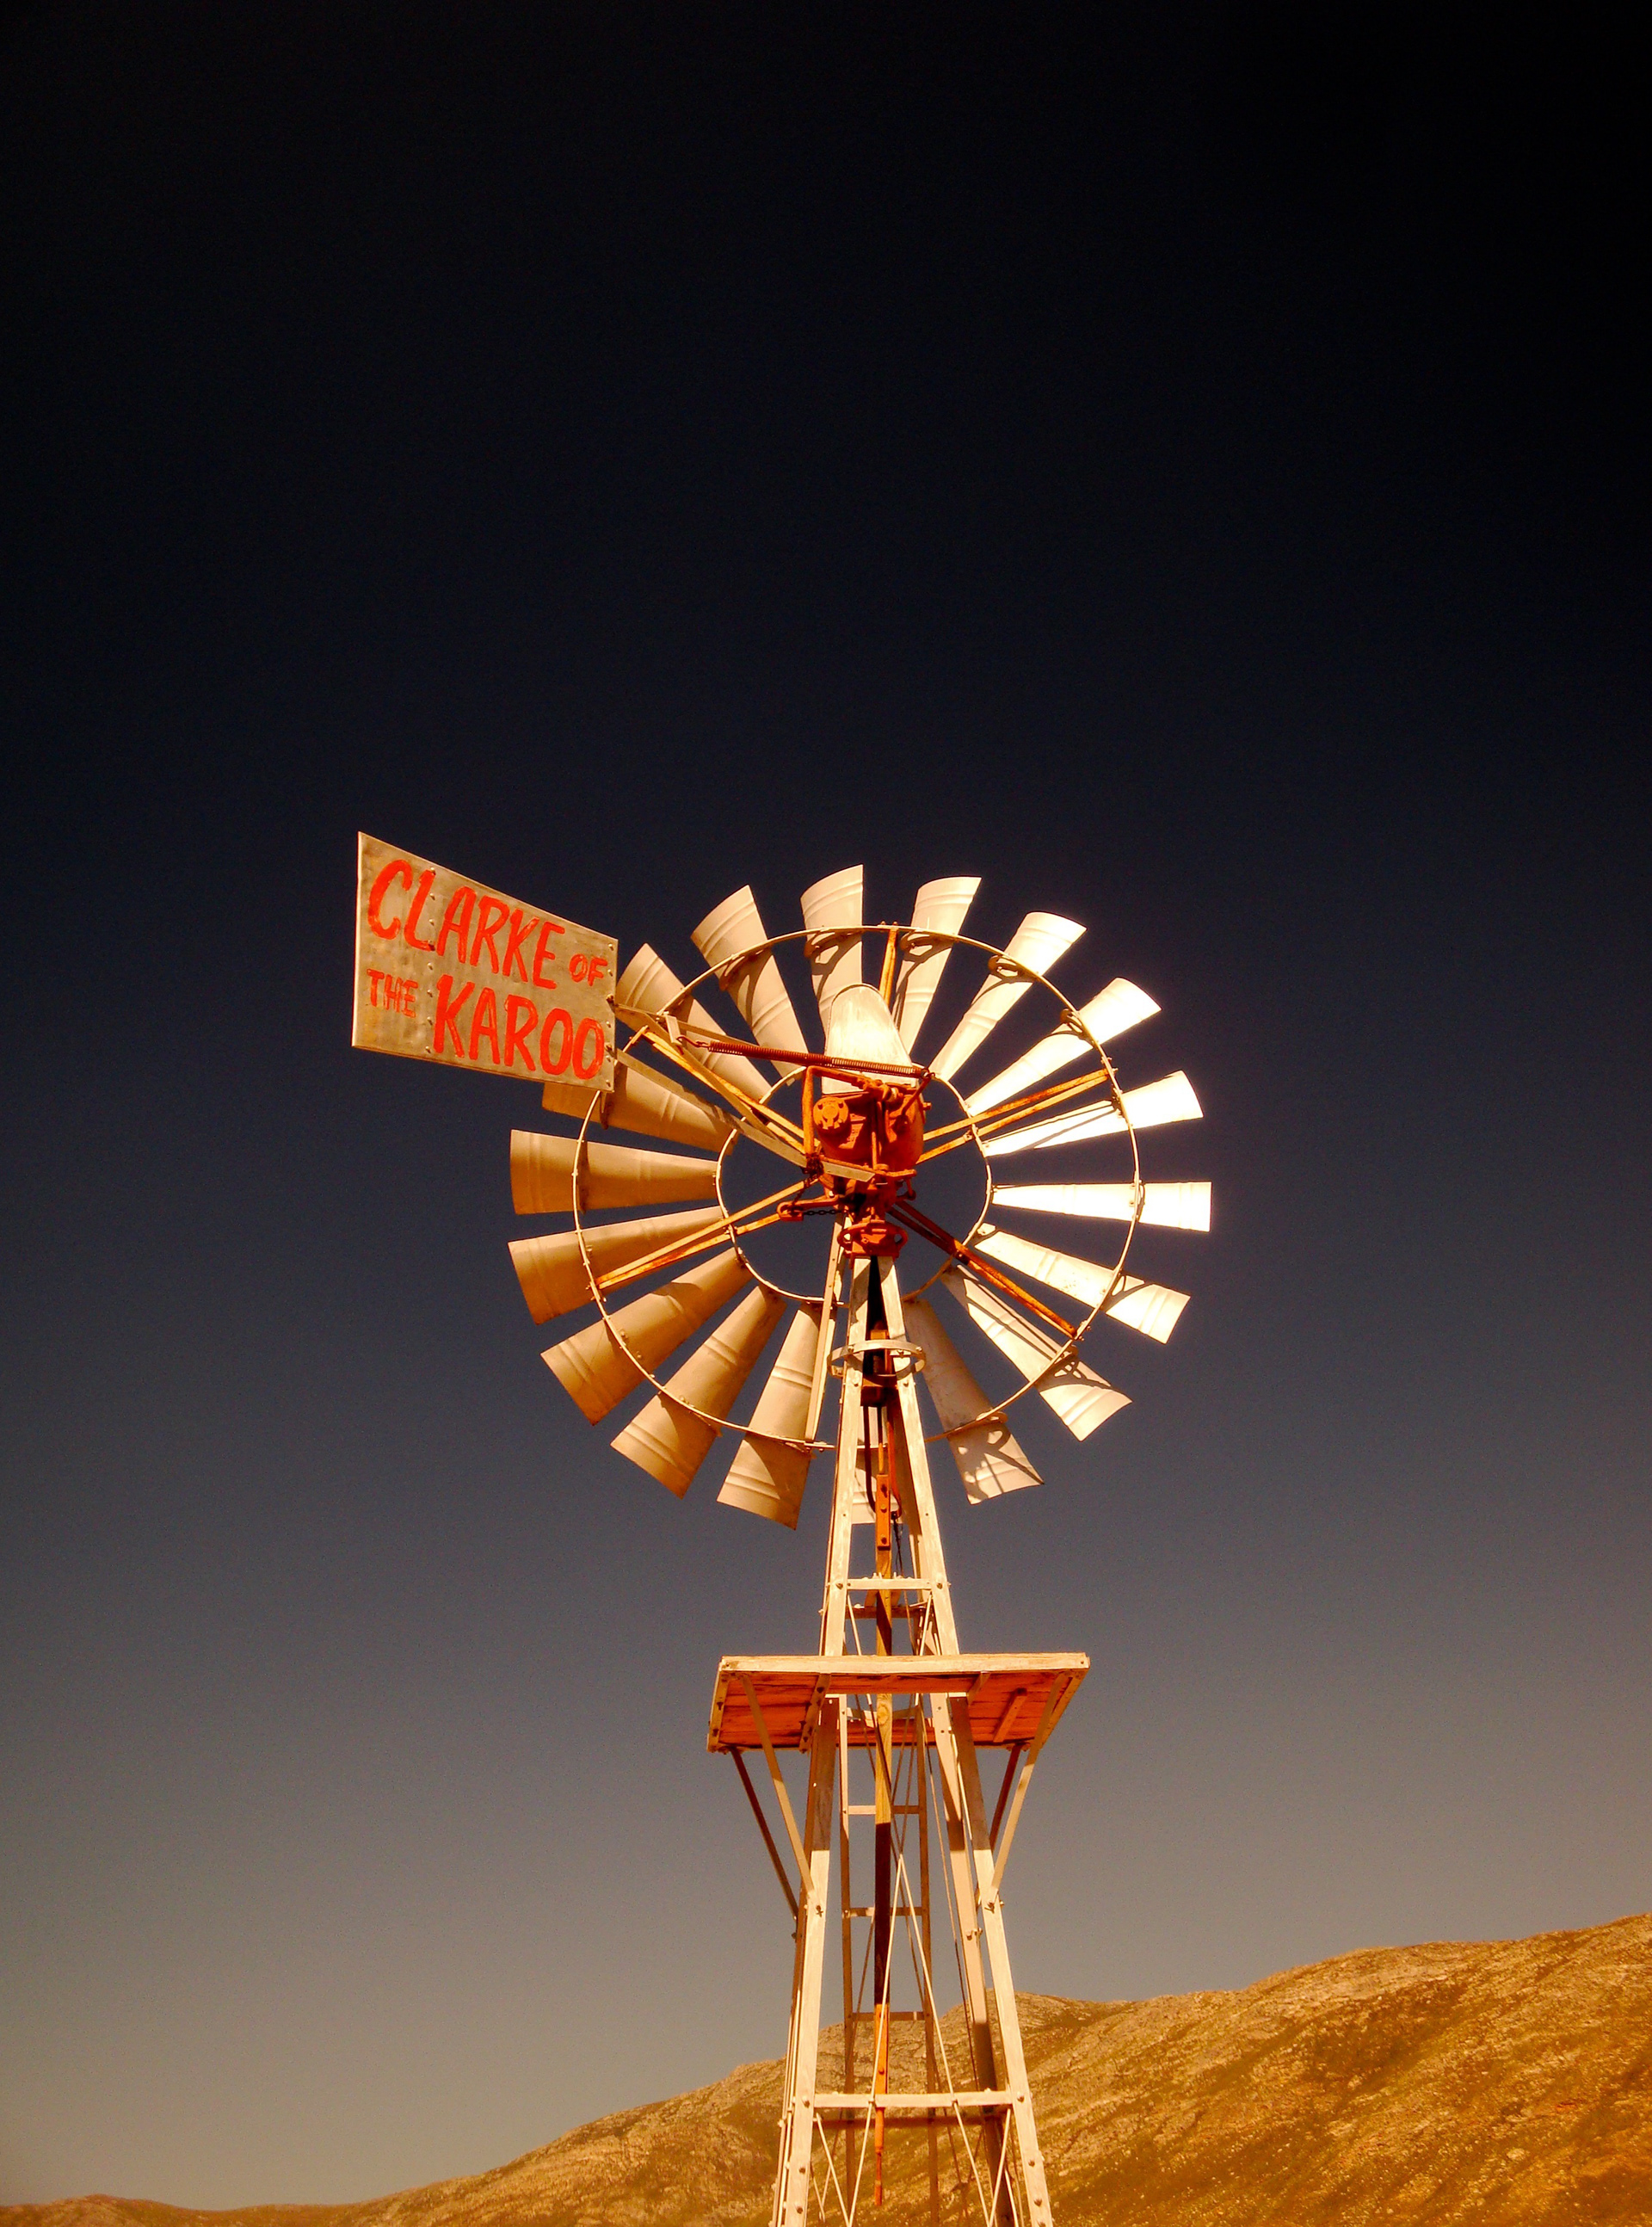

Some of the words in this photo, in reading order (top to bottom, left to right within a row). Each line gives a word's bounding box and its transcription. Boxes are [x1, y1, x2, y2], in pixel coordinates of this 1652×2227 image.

[367, 860, 565, 990] CLARKE
[568, 953, 608, 987] OF
[367, 968, 418, 1018] THE
[433, 974, 605, 1080] KAROO
